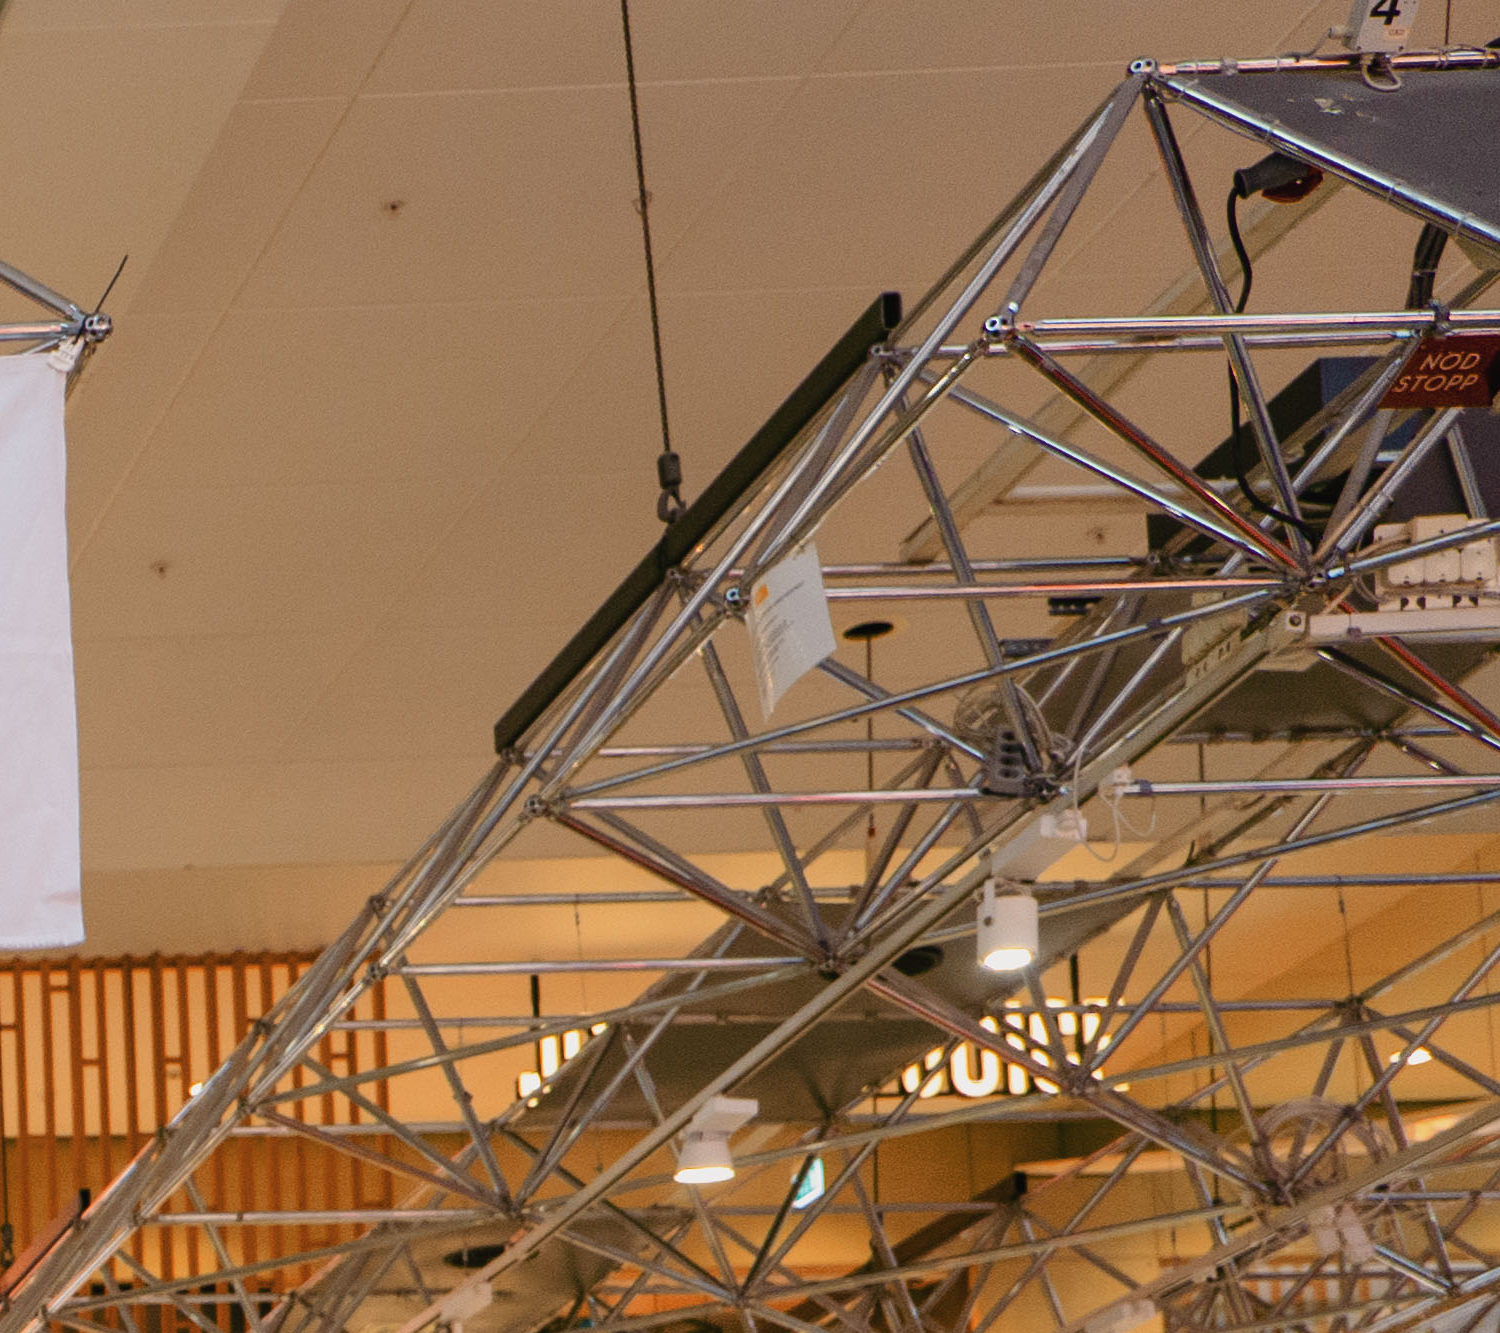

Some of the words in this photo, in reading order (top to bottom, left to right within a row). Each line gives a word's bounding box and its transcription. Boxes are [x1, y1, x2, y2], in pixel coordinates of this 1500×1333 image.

[1369, 0, 1401, 25] 4
[1420, 351, 1480, 371] NÖD
[1392, 373, 1478, 393] STOPP
